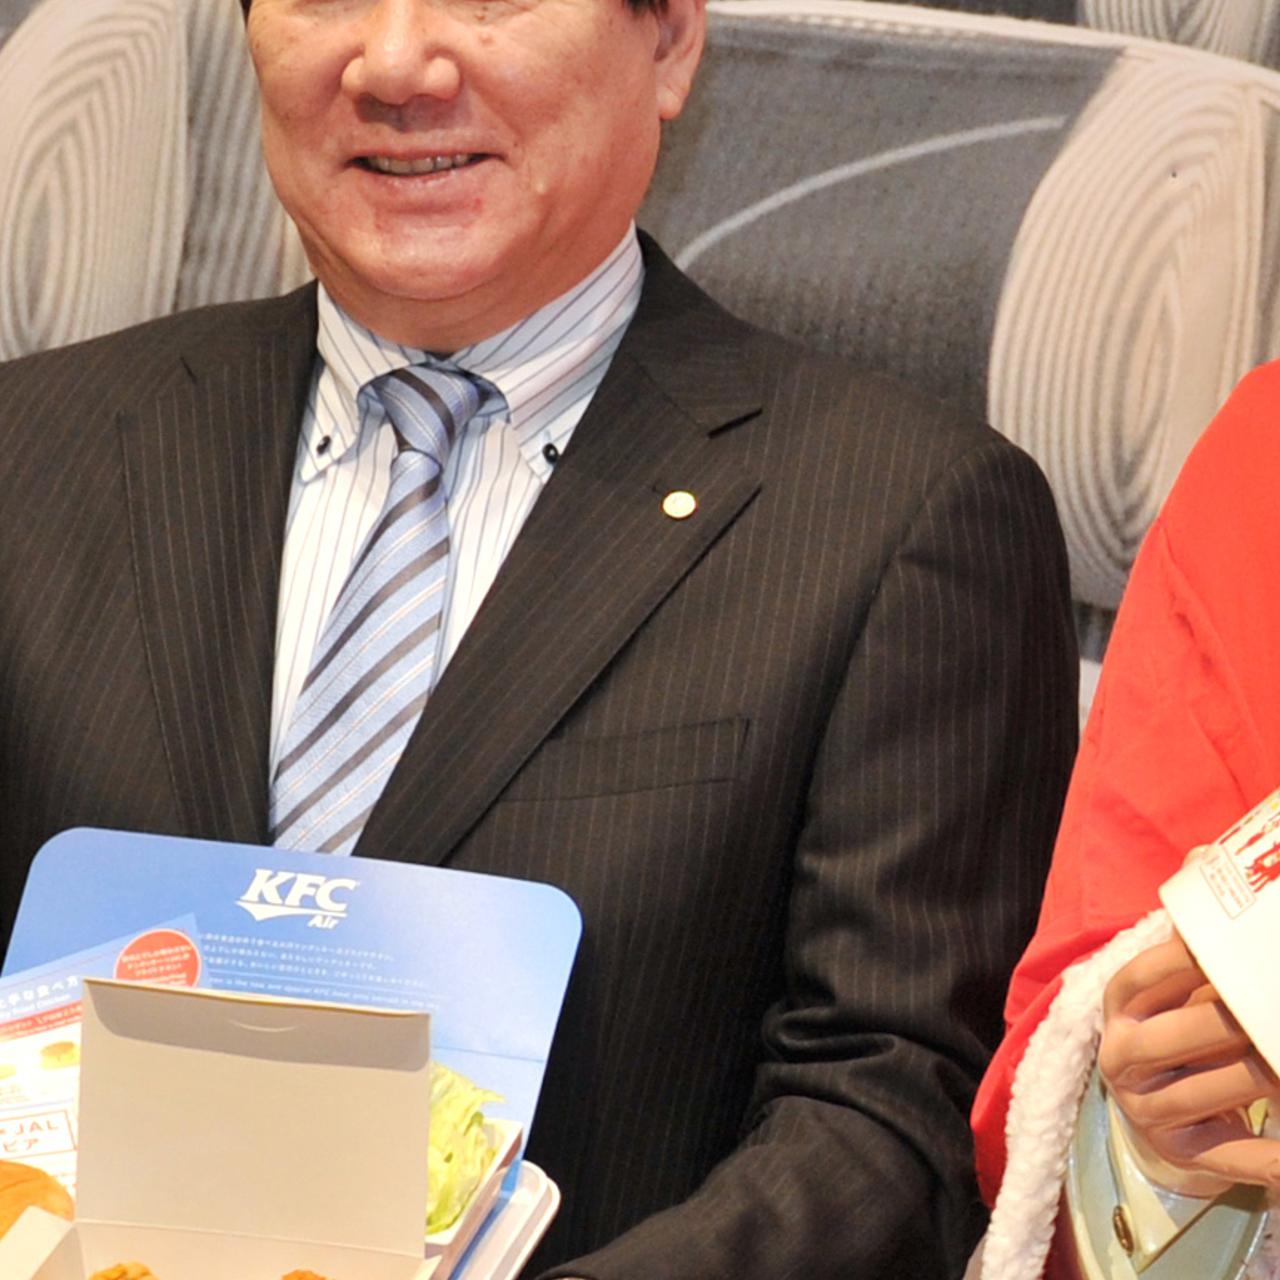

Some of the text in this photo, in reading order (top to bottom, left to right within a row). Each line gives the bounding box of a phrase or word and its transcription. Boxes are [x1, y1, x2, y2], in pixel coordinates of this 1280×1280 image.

[240, 868, 357, 912] KFC
[307, 914, 340, 929] Air
[16, 1120, 58, 1135] JAL
